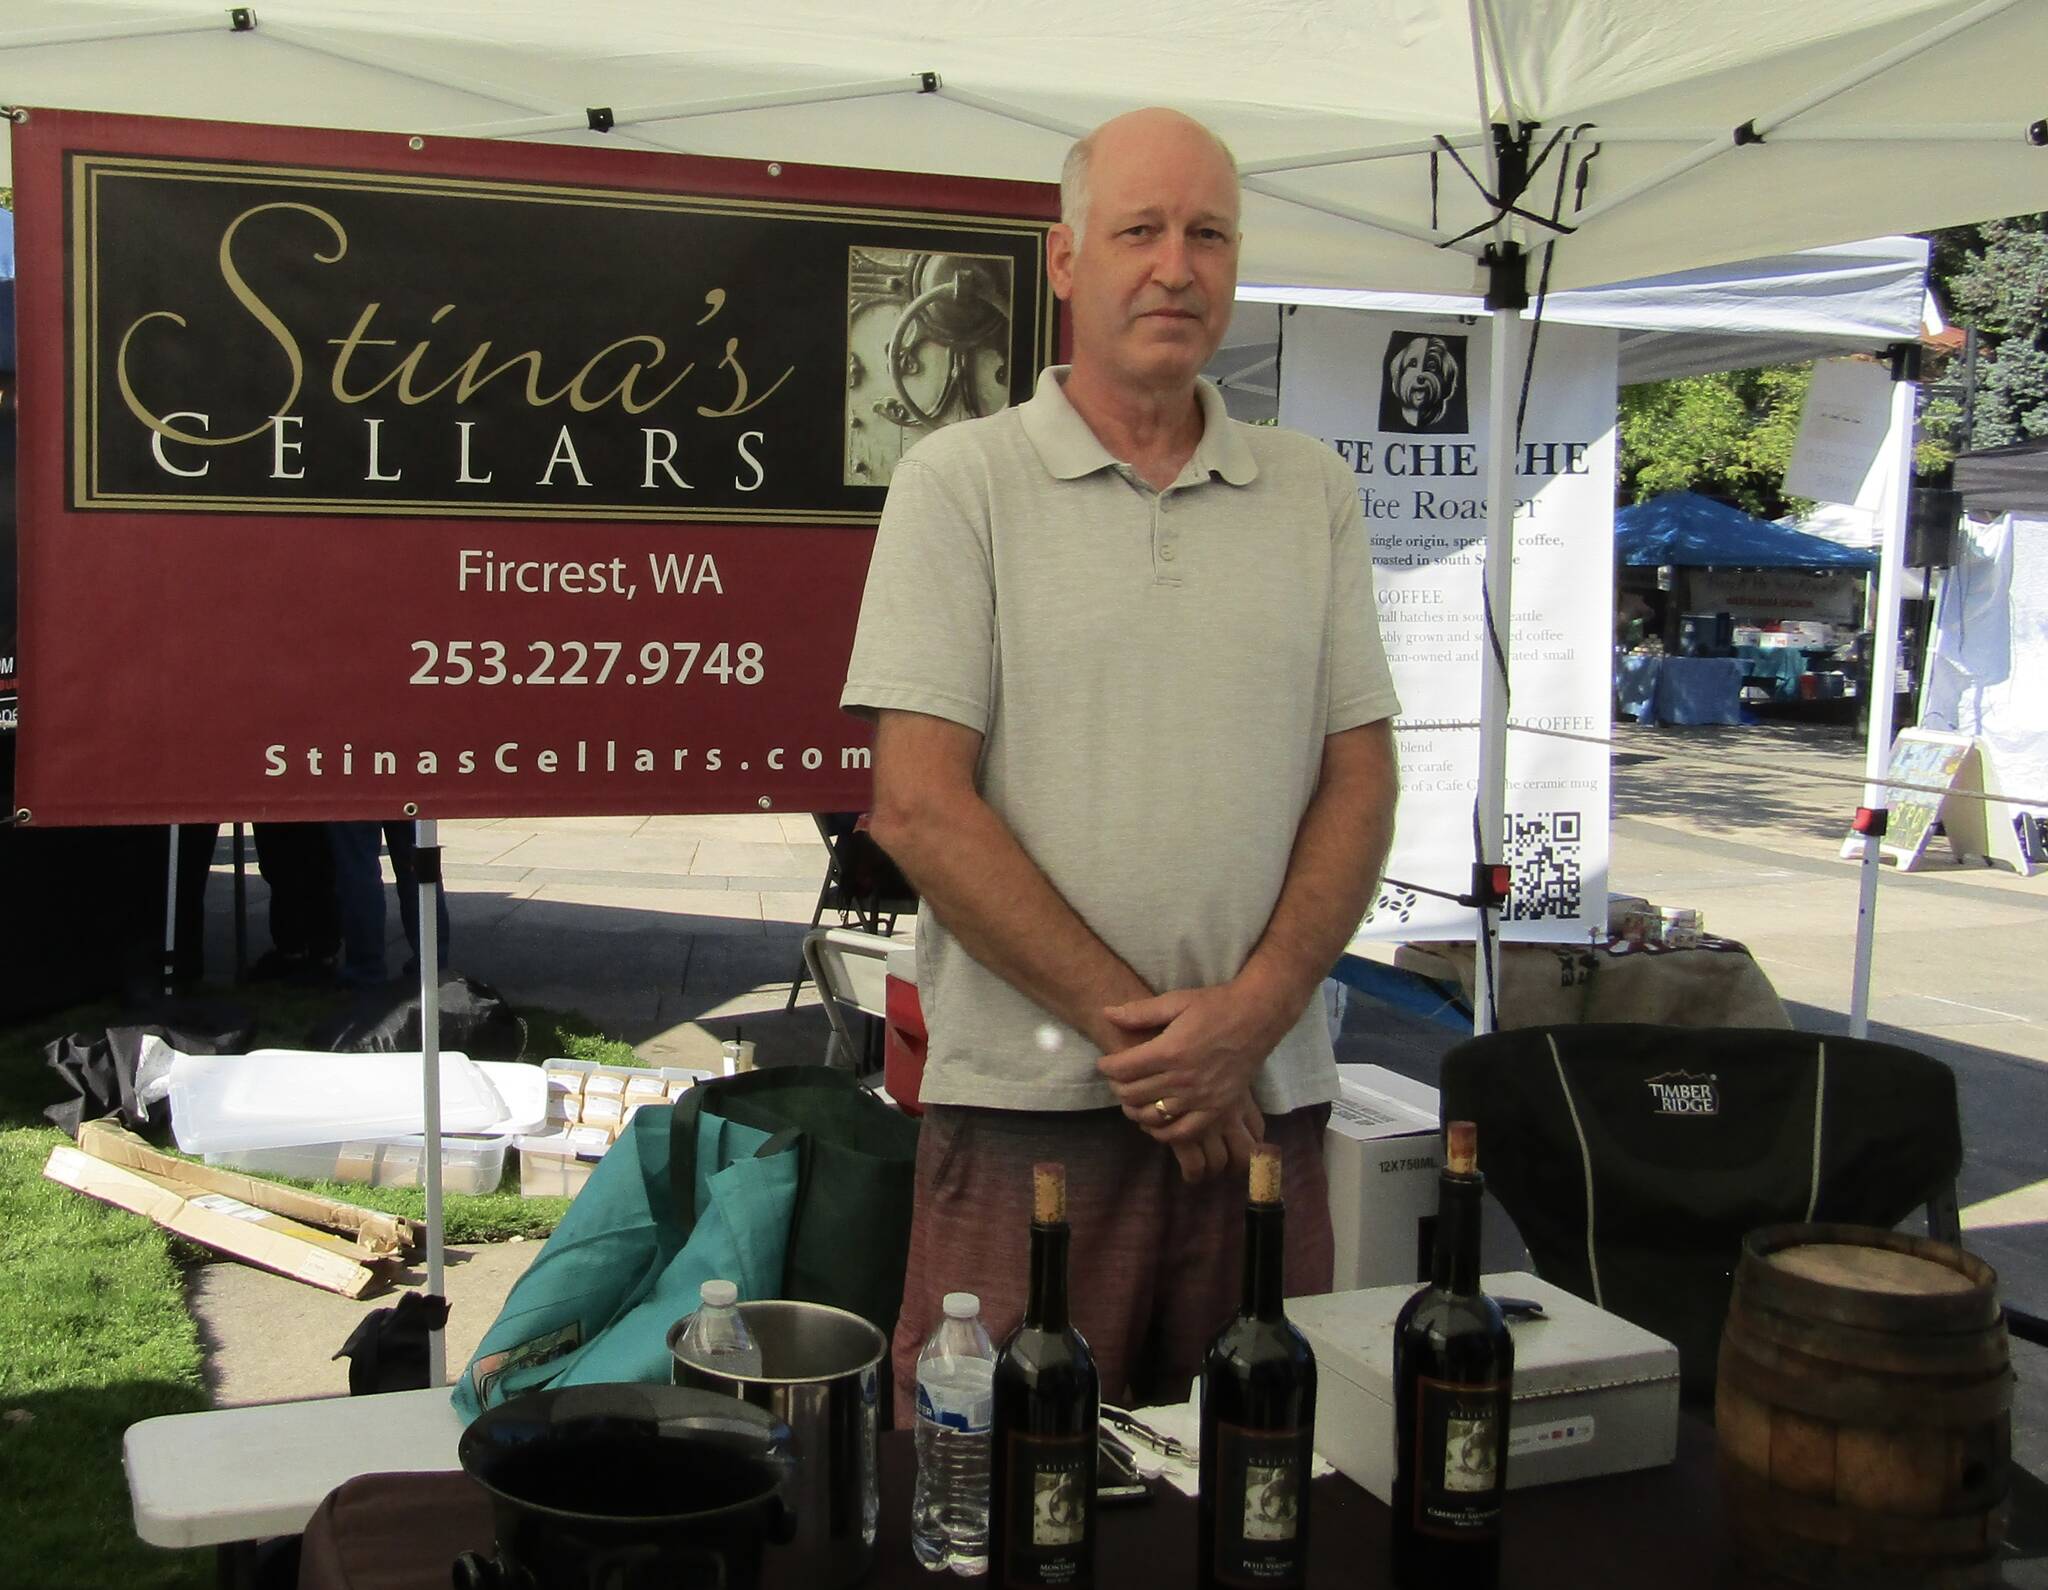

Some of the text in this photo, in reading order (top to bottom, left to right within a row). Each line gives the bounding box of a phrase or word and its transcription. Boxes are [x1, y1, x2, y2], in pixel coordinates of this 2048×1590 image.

[117, 201, 795, 446] Stina's
[151, 410, 766, 493] CELLARS
[1384, 441, 1590, 476] CHEHE
[1412, 489, 1543, 520] Roaser
[1369, 533, 1565, 550] single origin, speci coffee,
[1371, 554, 1413, 566] roasted
[1417, 553, 1430, 566] in
[1434, 553, 1470, 566] south
[458, 550, 724, 600] Fircrest, WA
[1377, 589, 1444, 605] COFFEE
[1399, 610, 1444, 623] batches
[1447, 613, 1459, 623] in
[1405, 632, 1444, 646] grown
[1448, 631, 1471, 643] and
[1526, 629, 1564, 641] coffee
[1455, 649, 1480, 662] and
[1542, 647, 1575, 661] small
[409, 640, 766, 686] 253.227.9748
[1526, 716, 1595, 731] COFFEE
[1400, 740, 1433, 753] blend
[265, 741, 872, 778] StinasCellars.com
[1417, 760, 1454, 772] carafe
[1411, 780, 1424, 792] of
[1426, 782, 1433, 792] a
[1436, 779, 1464, 791] Cafe
[1523, 777, 1568, 790] ceramic
[1570, 780, 1598, 791] mug
[1648, 1084, 1712, 1098] TIMBER
[1662, 1098, 1714, 1112] RIDGE
